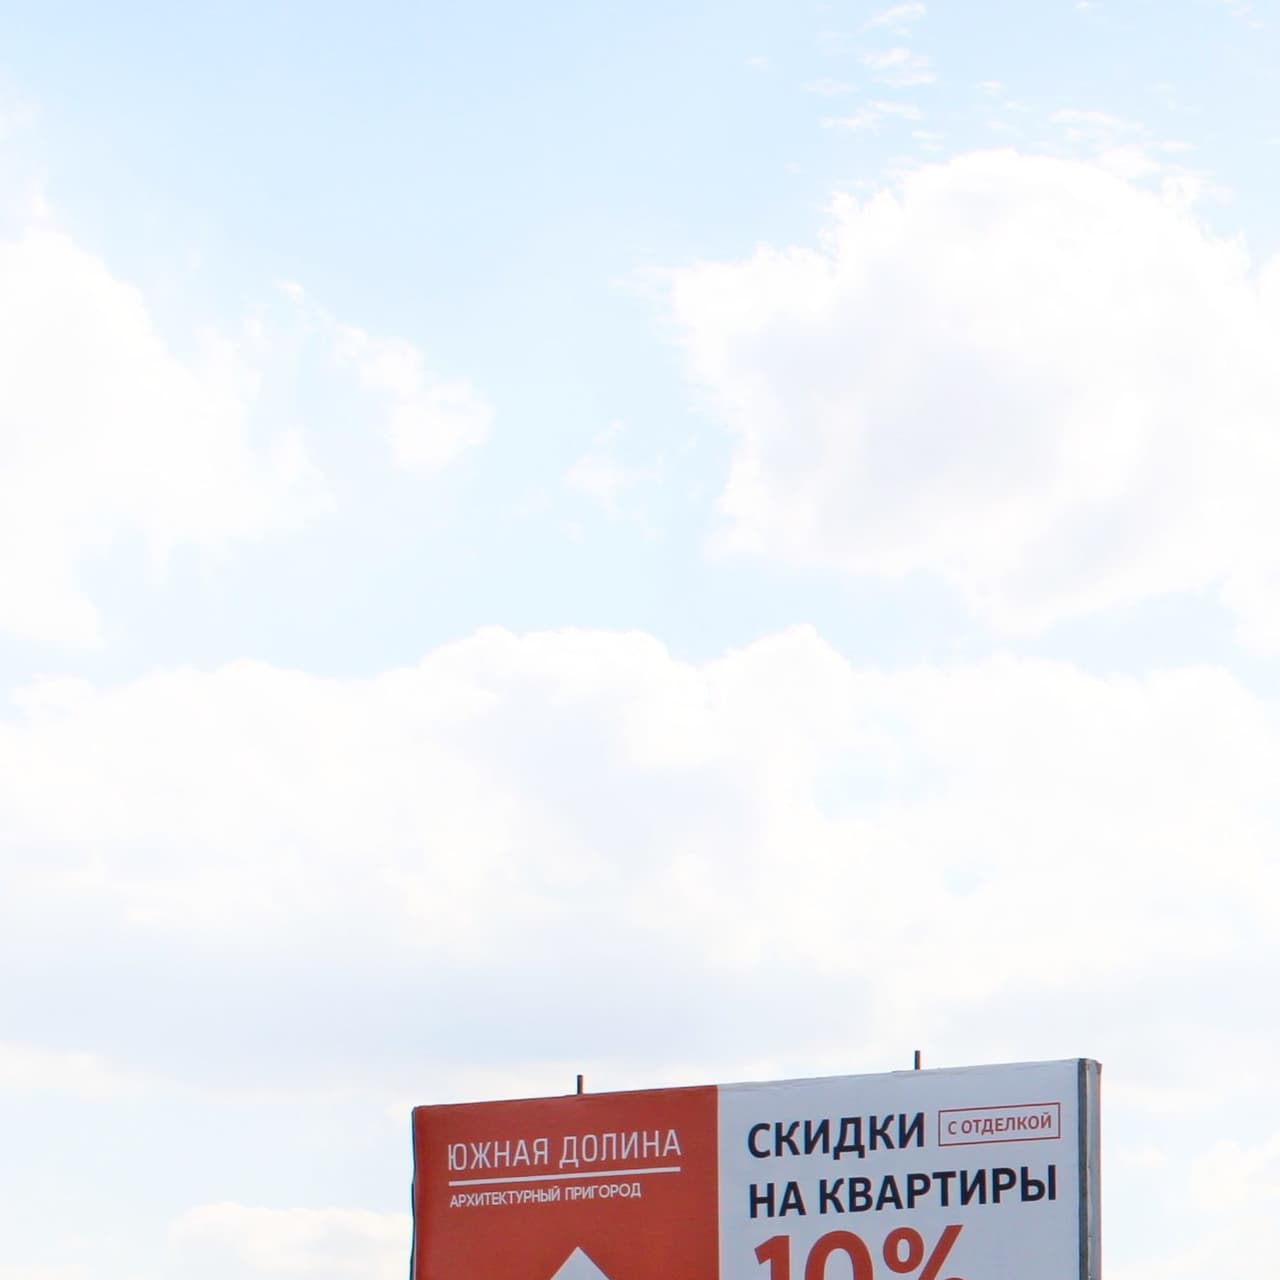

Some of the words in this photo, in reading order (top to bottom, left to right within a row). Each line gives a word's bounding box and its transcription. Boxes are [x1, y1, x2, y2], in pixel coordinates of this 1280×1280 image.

[747, 1112, 925, 1160] СКИДКИ
[947, 1119, 957, 1136] С
[961, 1111, 1052, 1135] ОТДЕЛКОЙ
[447, 1137, 549, 1171] ЮЖНАЯ
[559, 1128, 682, 1168] ДОЛИНА
[449, 1186, 560, 1208] АРХИТЕКТУРНЫЙ
[564, 1182, 642, 1201] ПРИГОРОД
[749, 1181, 806, 1218] НА
[819, 1164, 1057, 1214] КВАРТИРЫ
